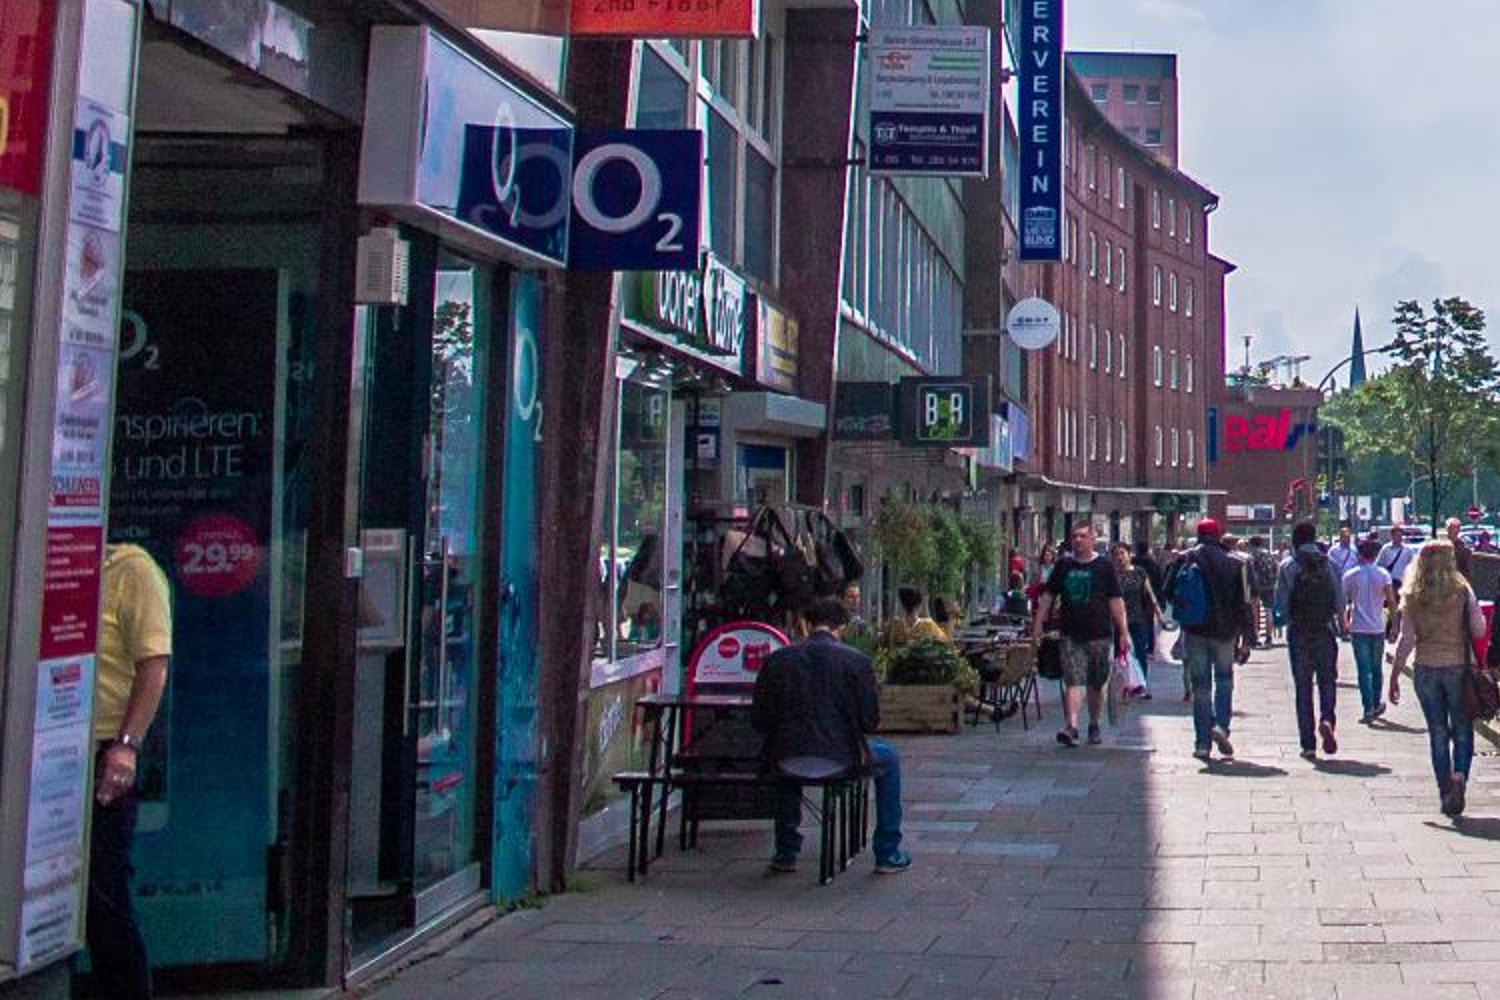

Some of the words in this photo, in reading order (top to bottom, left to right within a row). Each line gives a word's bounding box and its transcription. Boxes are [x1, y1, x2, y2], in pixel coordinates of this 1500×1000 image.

[572, 142, 684, 252] O2
[124, 444, 187, 481] und
[193, 443, 245, 479] LTE
